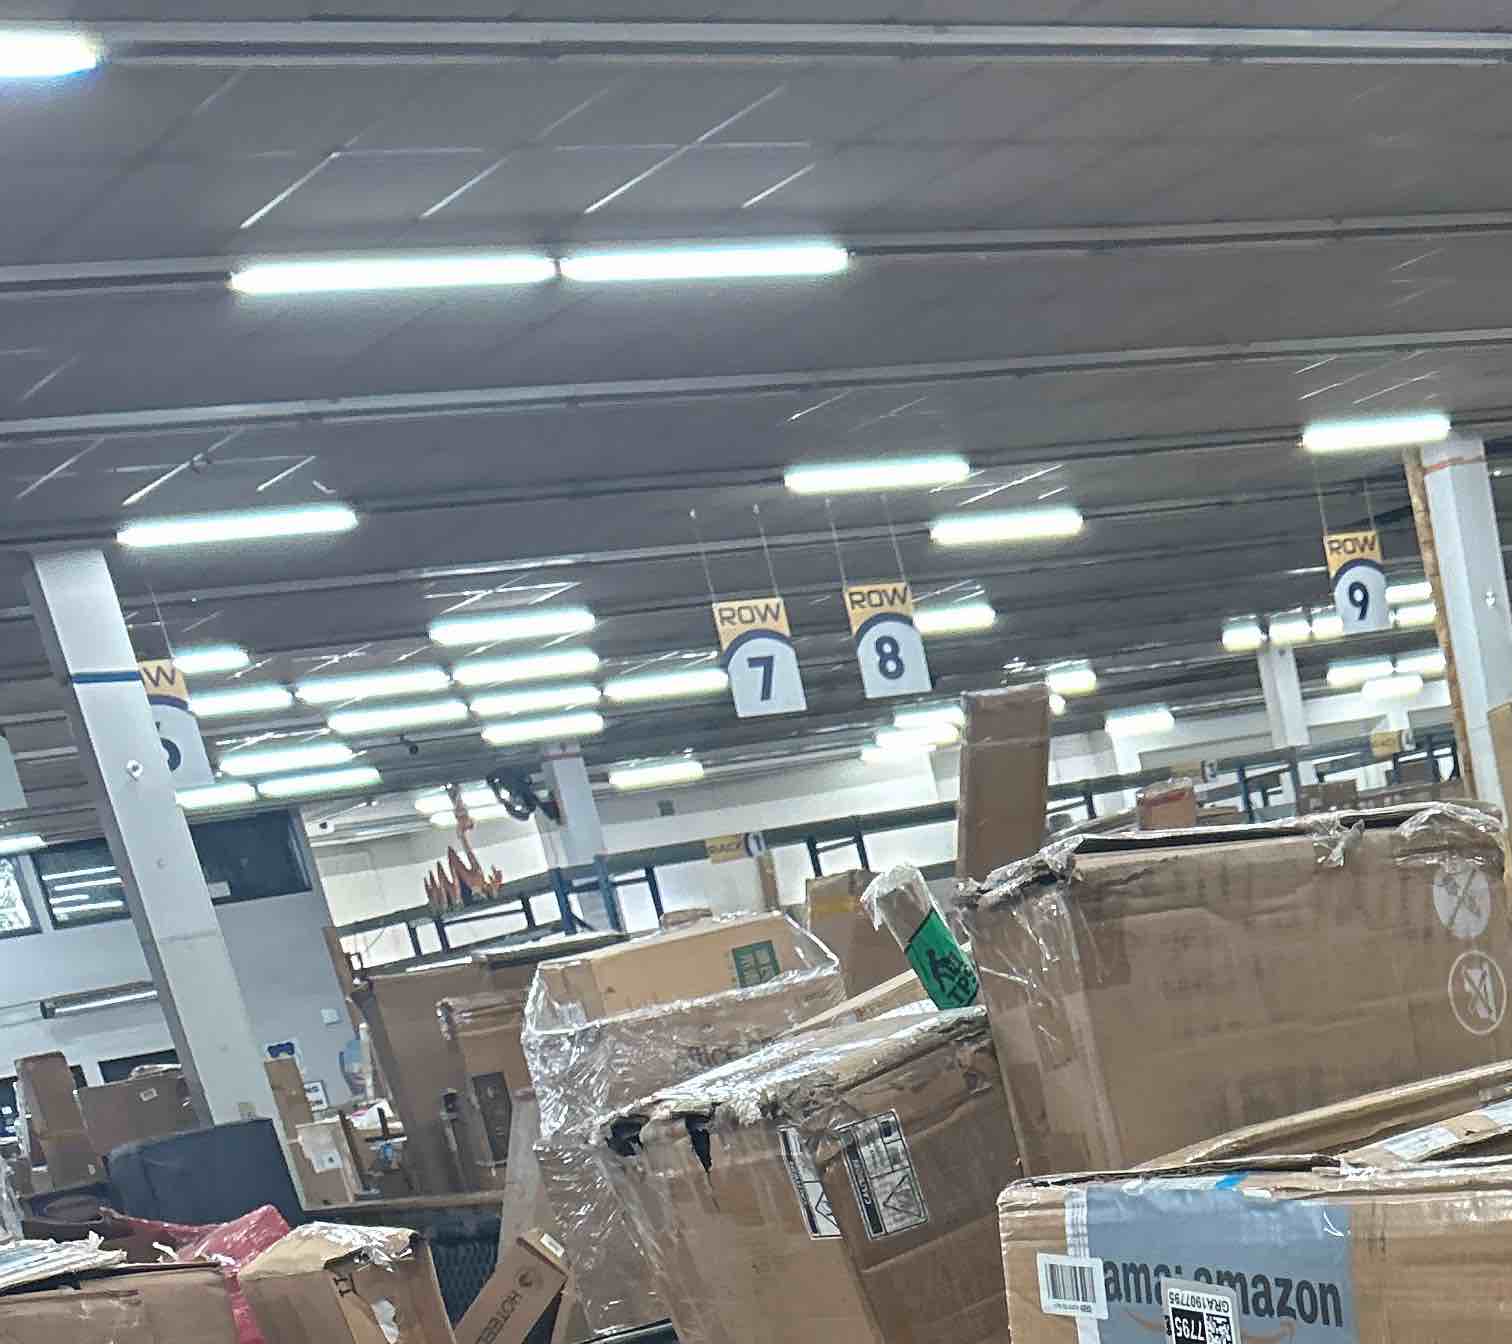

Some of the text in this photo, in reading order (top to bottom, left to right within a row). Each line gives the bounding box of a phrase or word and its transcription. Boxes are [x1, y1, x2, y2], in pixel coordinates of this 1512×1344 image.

[1327, 535, 1376, 554] ROW
[850, 586, 907, 608] ROW
[1349, 581, 1369, 620] 9
[718, 602, 781, 626] ROW
[875, 635, 905, 680] 8
[746, 655, 774, 701] 7
[1175, 1317, 1204, 1341] 7795
